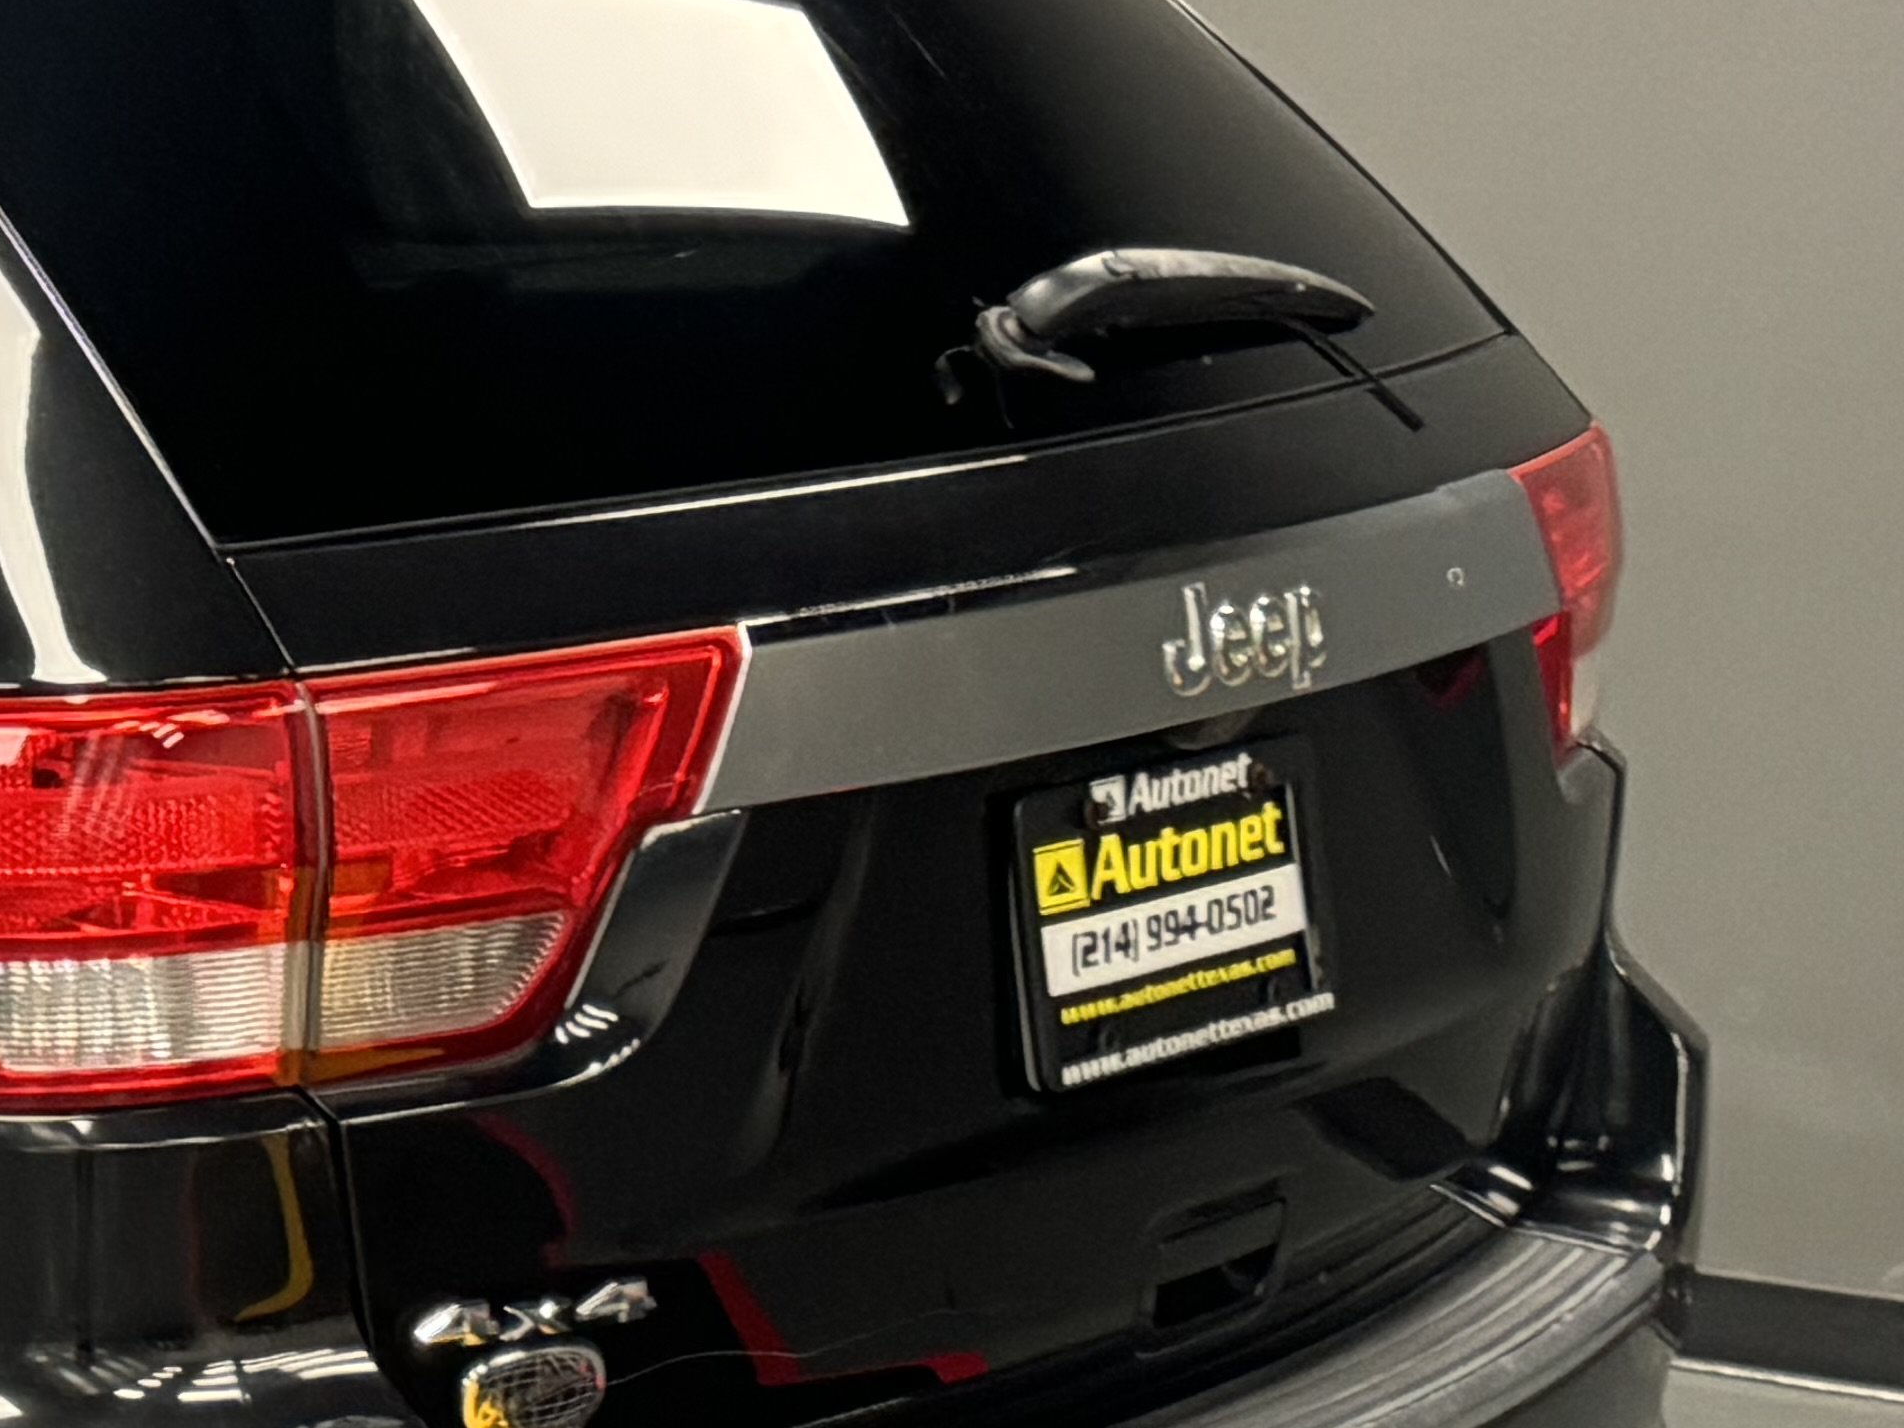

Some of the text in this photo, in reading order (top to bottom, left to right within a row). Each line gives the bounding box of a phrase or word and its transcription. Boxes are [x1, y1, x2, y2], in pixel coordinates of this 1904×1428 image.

[1162, 581, 1326, 696] Jeep
[1127, 752, 1252, 815] Autonet
[1092, 801, 1285, 900] Autonet
[1072, 885, 1276, 976] (214) 994-0502
